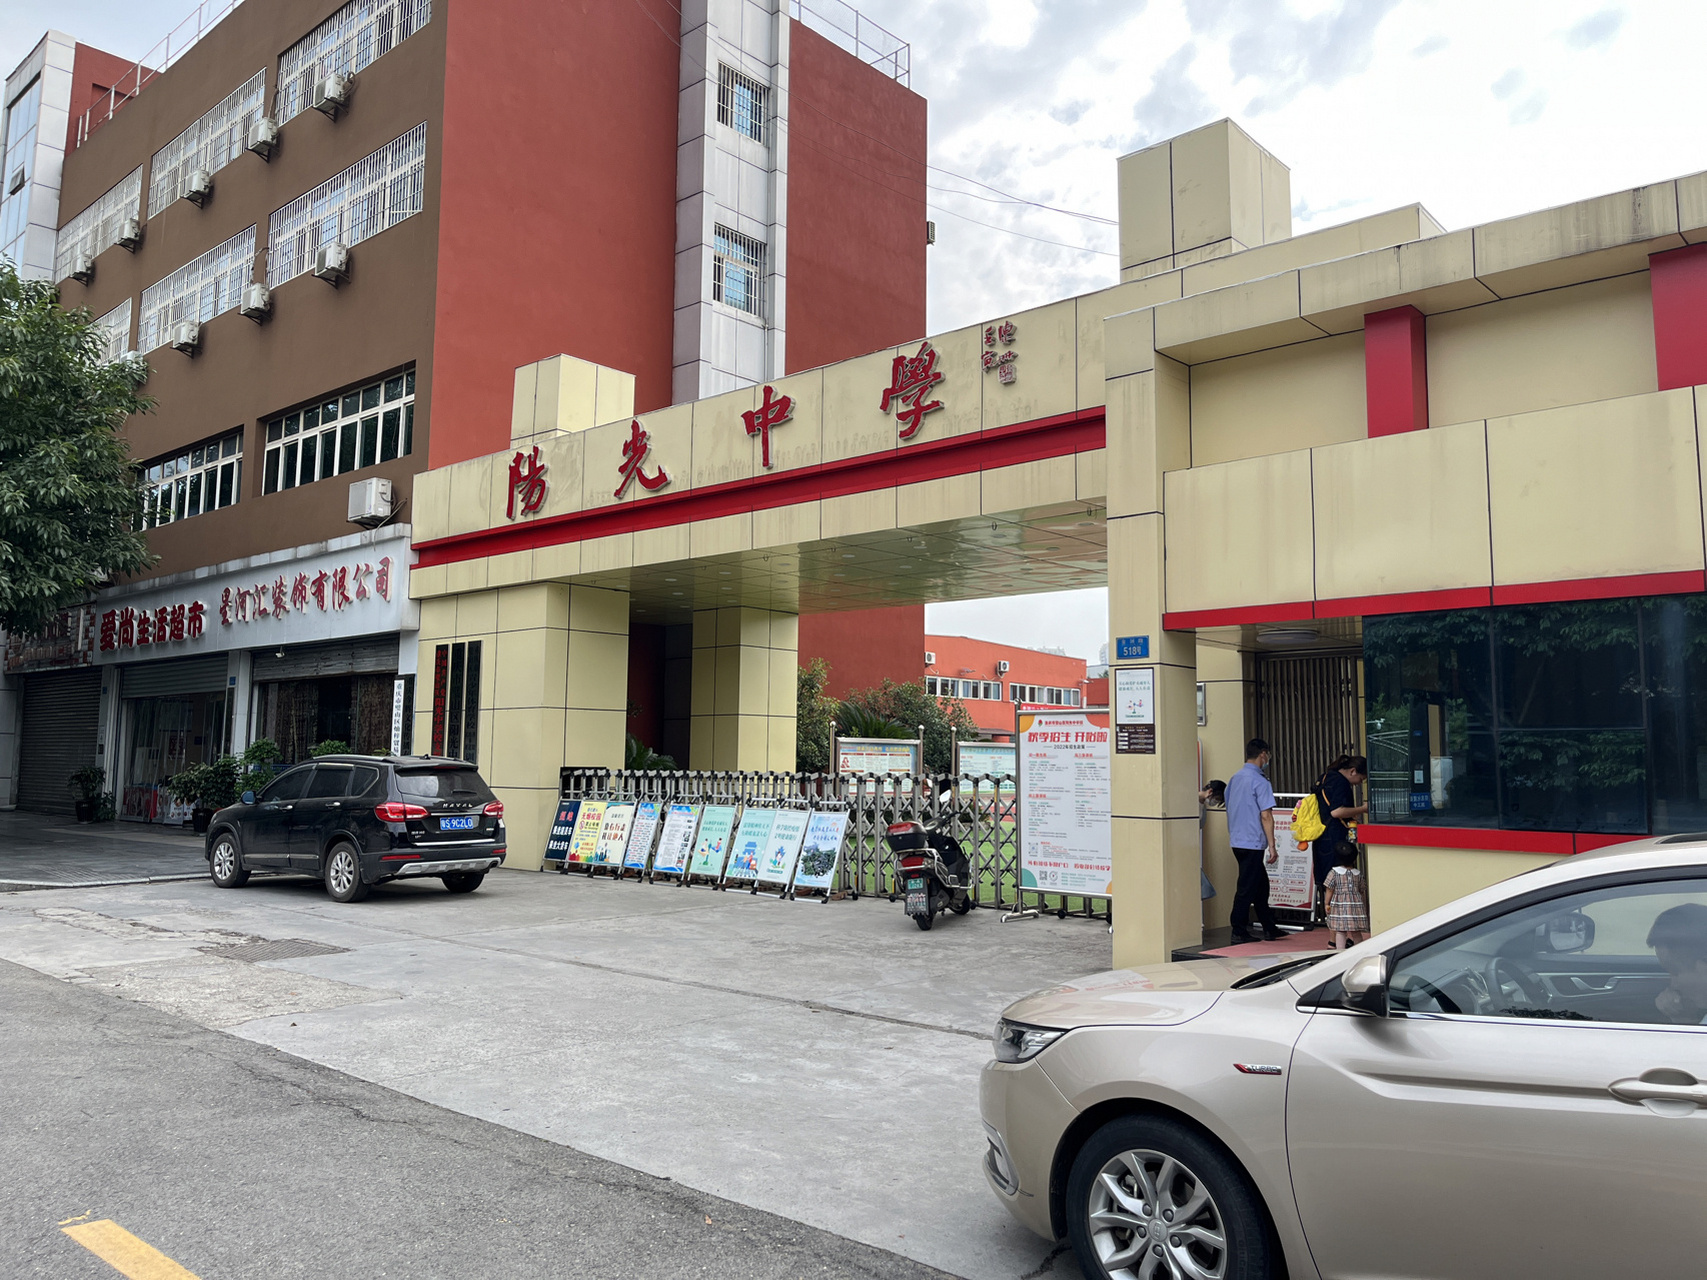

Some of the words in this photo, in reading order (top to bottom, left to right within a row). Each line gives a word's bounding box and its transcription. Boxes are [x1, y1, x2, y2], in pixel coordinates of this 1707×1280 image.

[219, 555, 393, 626] 星河汇装饰有限公司
[99, 600, 207, 653] 爱尚生活超市
[1123, 646, 1142, 657] 518号
[1028, 731, 1071, 743] 秋季招生
[1251, 1065, 1278, 1073] TURBO
